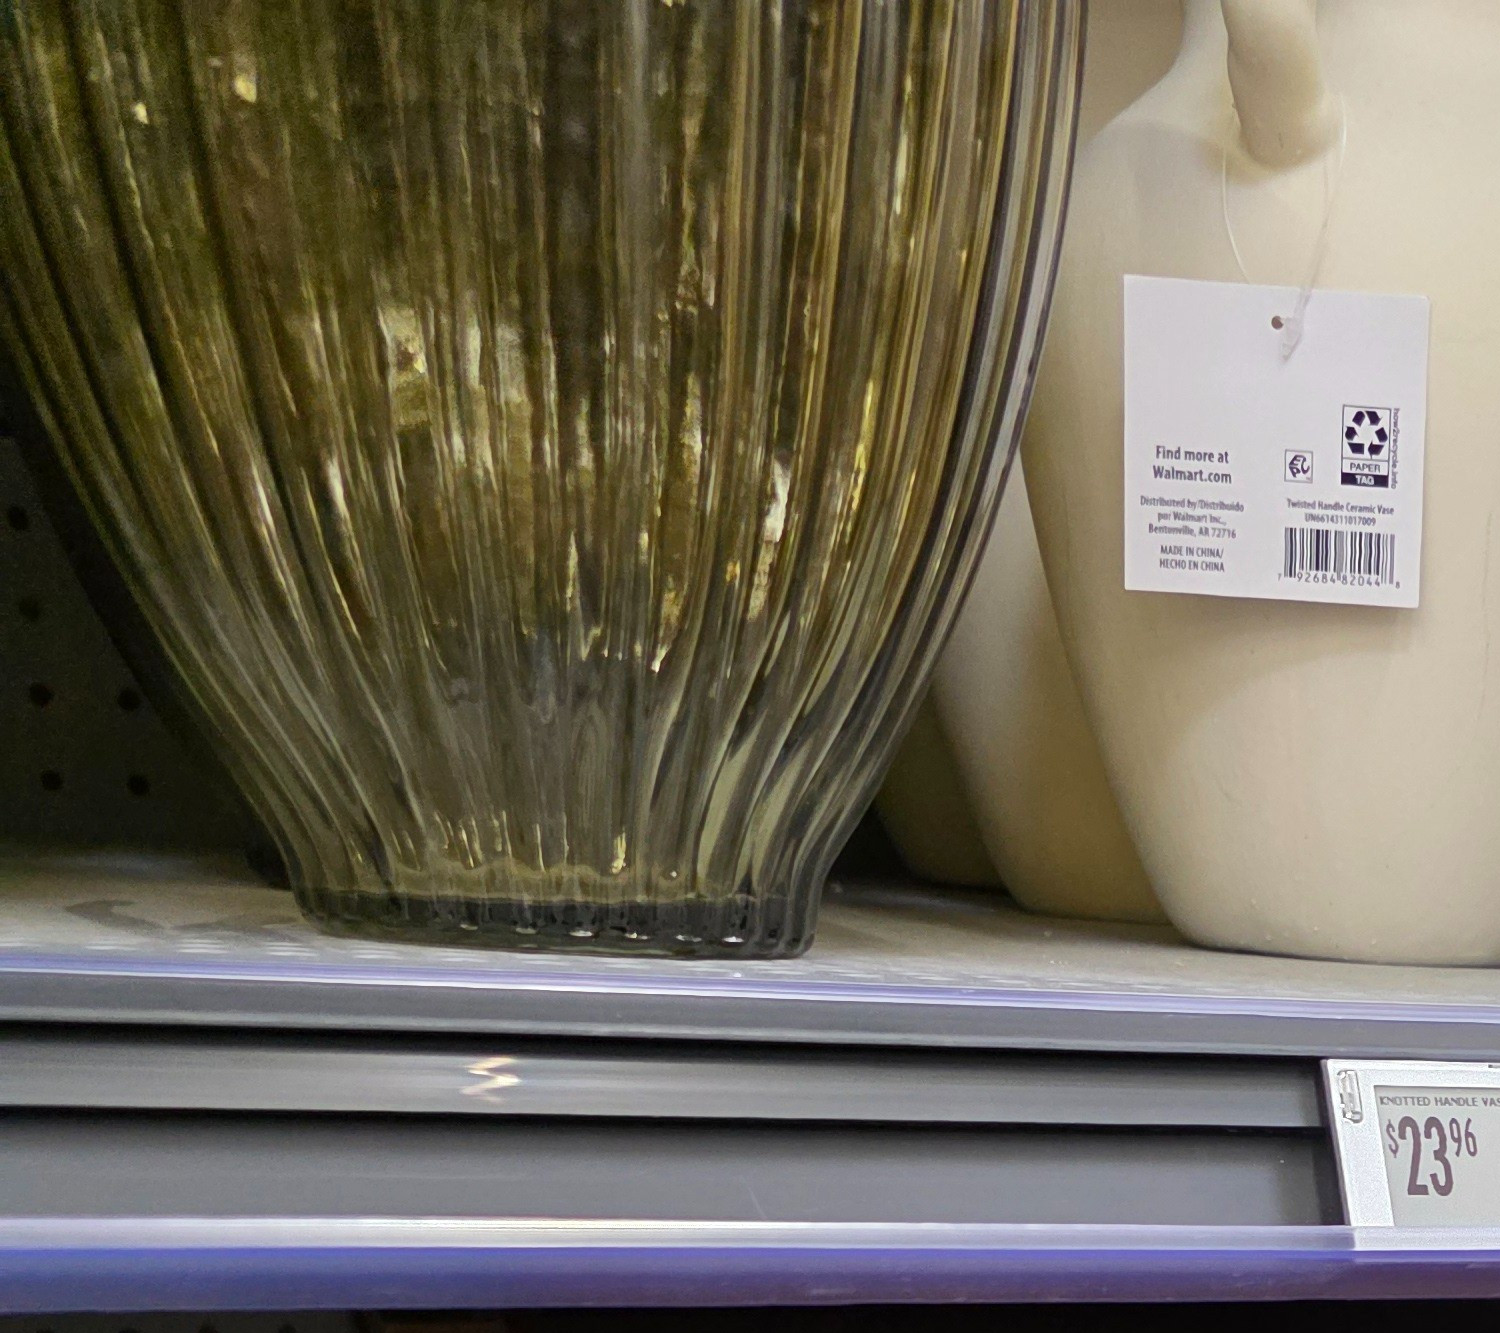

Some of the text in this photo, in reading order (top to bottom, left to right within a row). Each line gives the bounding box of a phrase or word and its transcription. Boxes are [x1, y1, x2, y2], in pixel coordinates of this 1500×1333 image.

[1155, 445, 1229, 464] Find more at
[1349, 462, 1381, 473] PAPER
[1152, 465, 1232, 484] Walmart.com
[1354, 474, 1375, 486] TAG
[1140, 495, 1186, 508] Distributed
[1286, 498, 1395, 515] Twisted Handle Ceramic Vase
[1157, 512, 1171, 523] por
[1172, 511, 1208, 524] Walmart
[1148, 523, 1237, 539] Bentonville, AR 72716
[1160, 545, 1183, 556] MADE
[1185, 546, 1195, 557] IN
[1159, 558, 1225, 573] HECHO EN CHINA
[1379, 1096, 1431, 1107] KNOTTED
[1434, 1097, 1479, 1107] HANDLE
